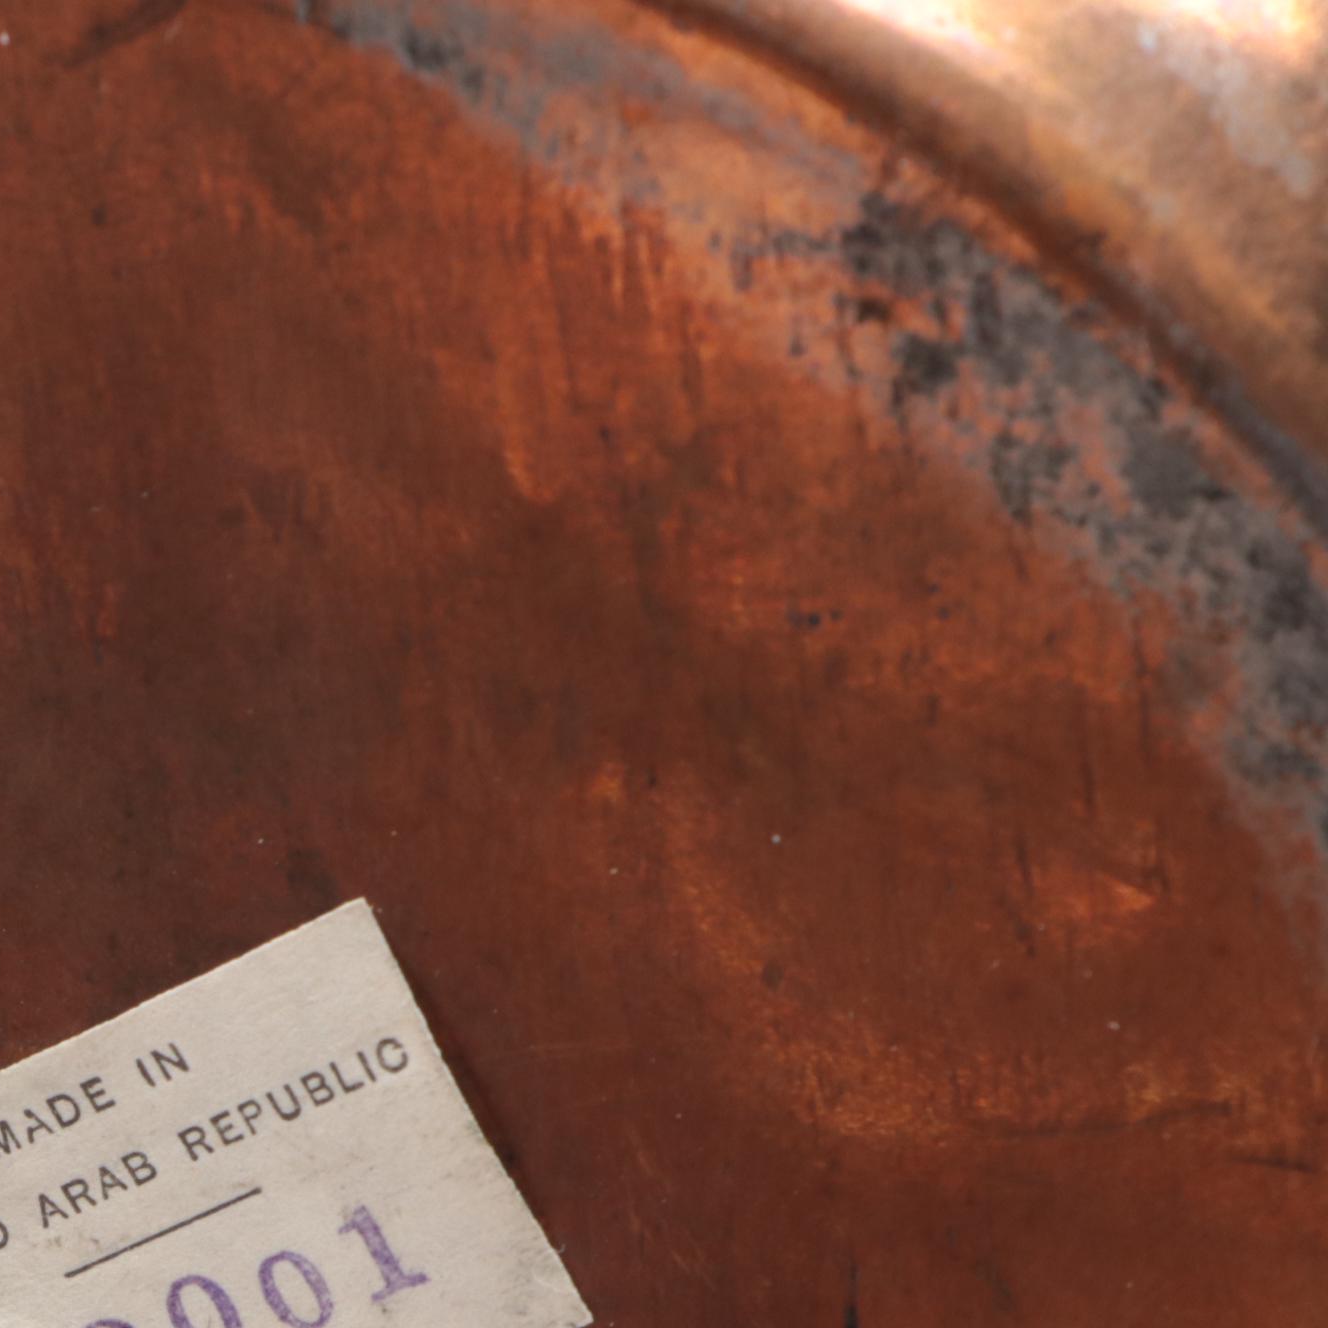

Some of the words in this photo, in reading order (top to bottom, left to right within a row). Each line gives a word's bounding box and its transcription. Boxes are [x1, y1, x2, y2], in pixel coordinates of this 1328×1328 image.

[135, 1042, 190, 1088] IN
[37, 1151, 158, 1230] ARAB
[176, 1036, 410, 1163] REPUBLIC
